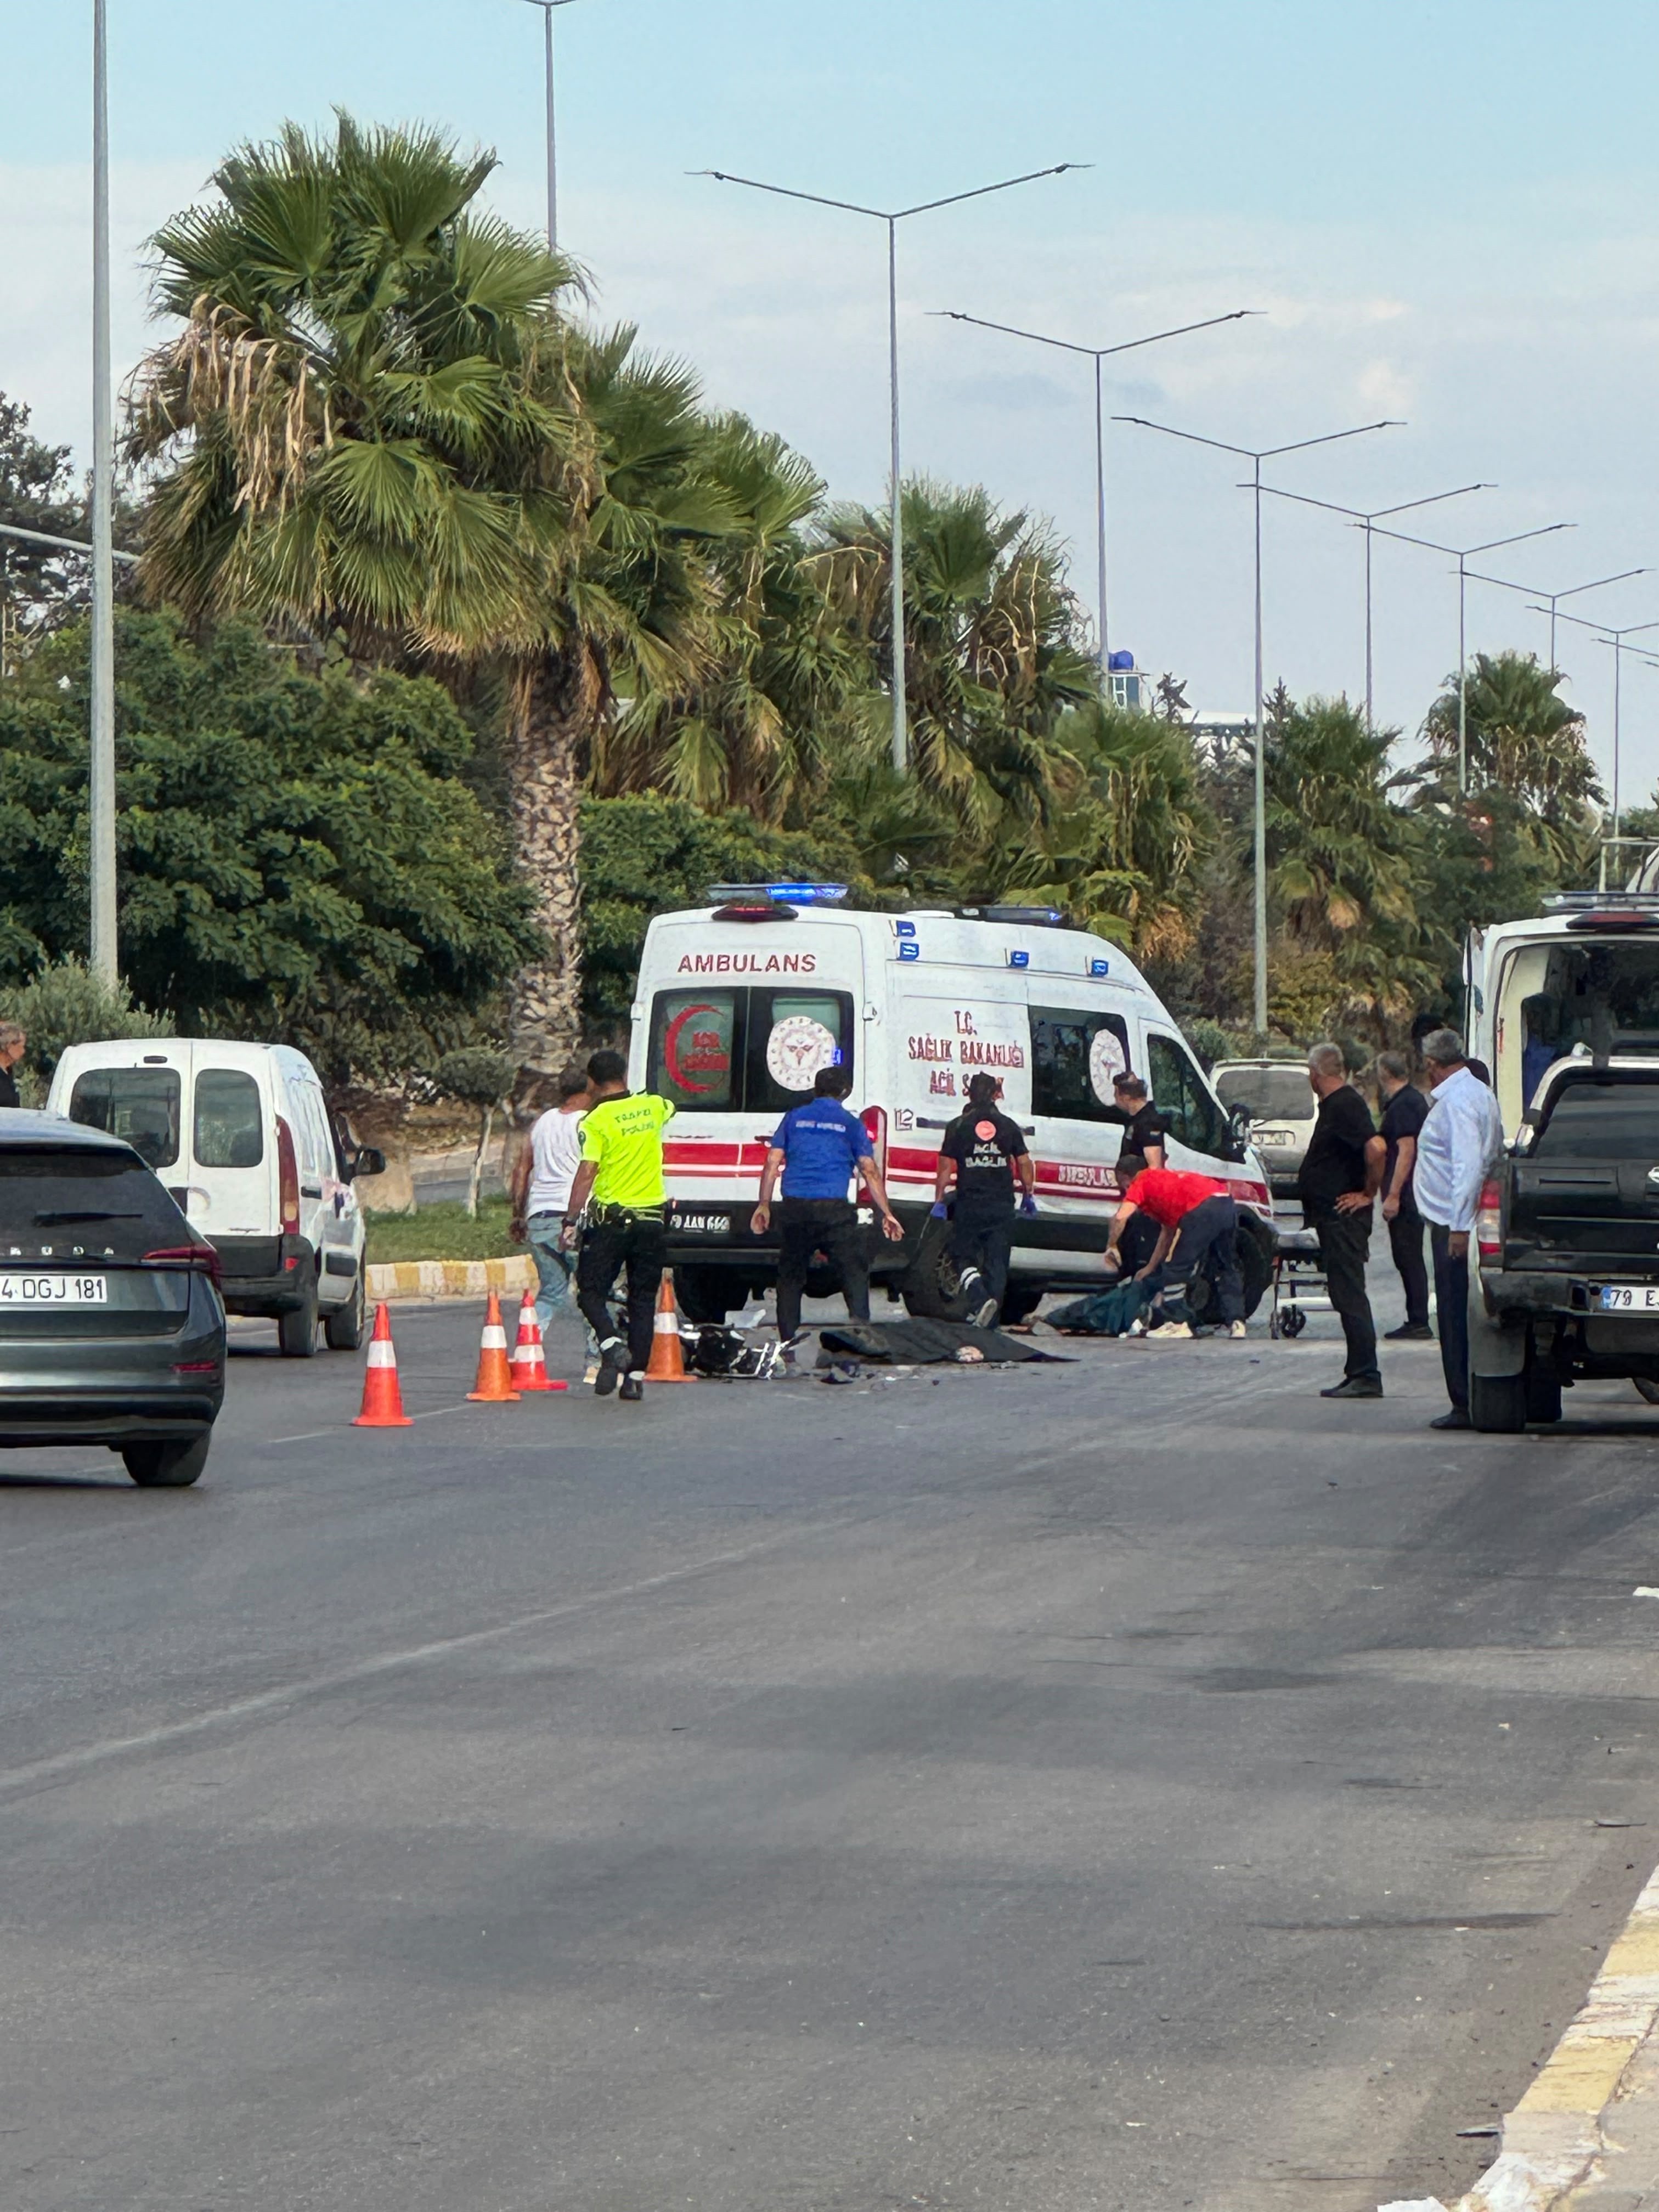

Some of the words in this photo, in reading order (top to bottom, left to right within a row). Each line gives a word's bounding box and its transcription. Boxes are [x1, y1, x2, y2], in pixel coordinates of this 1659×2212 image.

[677, 954, 816, 973] AMBULANS
[22, 1277, 66, 1300] DGJ
[75, 1278, 103, 1300] 181
